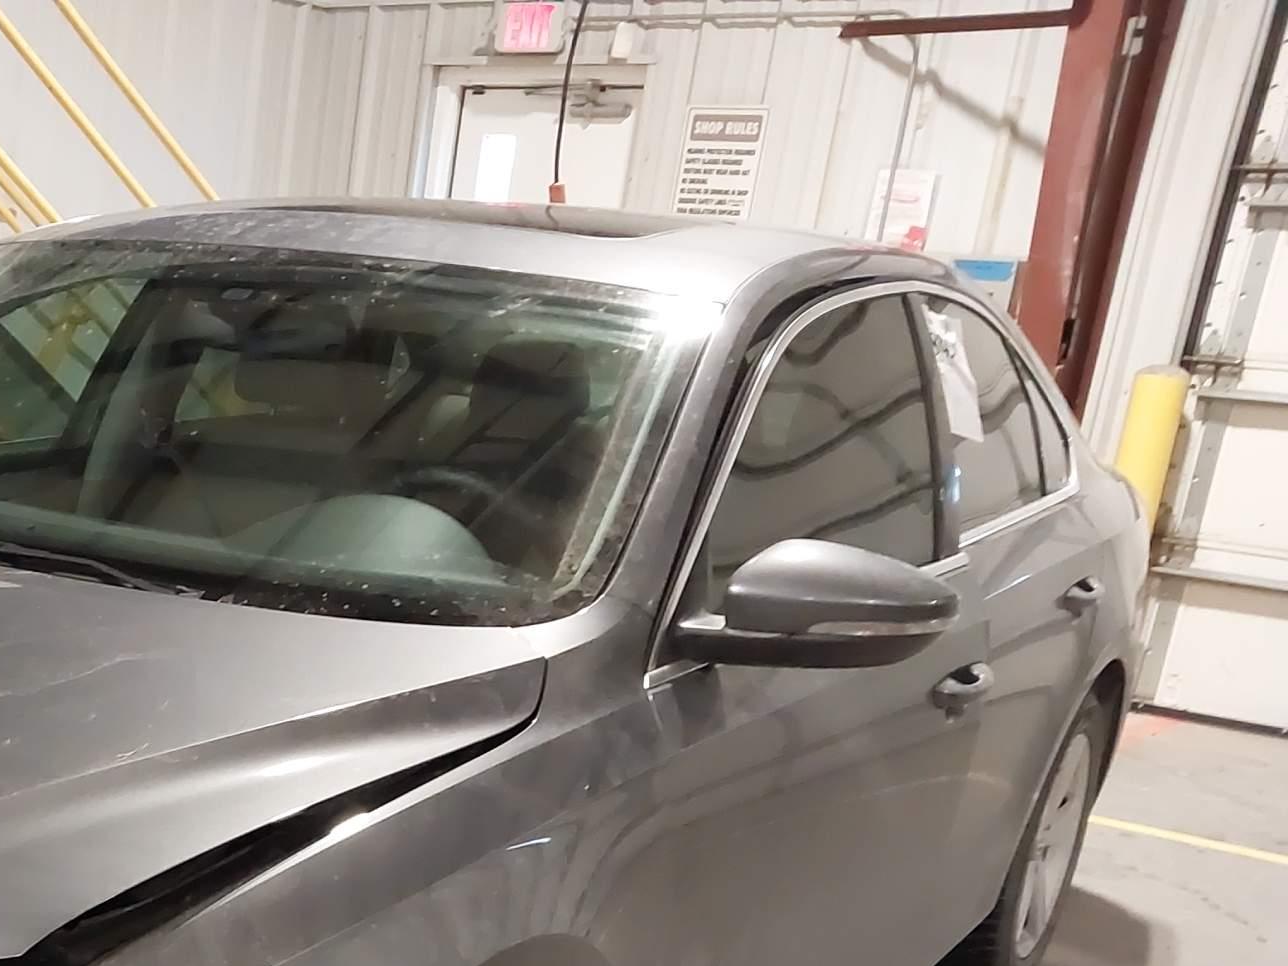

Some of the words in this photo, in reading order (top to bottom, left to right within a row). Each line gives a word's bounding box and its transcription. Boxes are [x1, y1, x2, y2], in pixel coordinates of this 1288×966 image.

[504, 5, 552, 48] EXIT
[693, 121, 724, 135] SHOP
[724, 121, 760, 135] RULES
